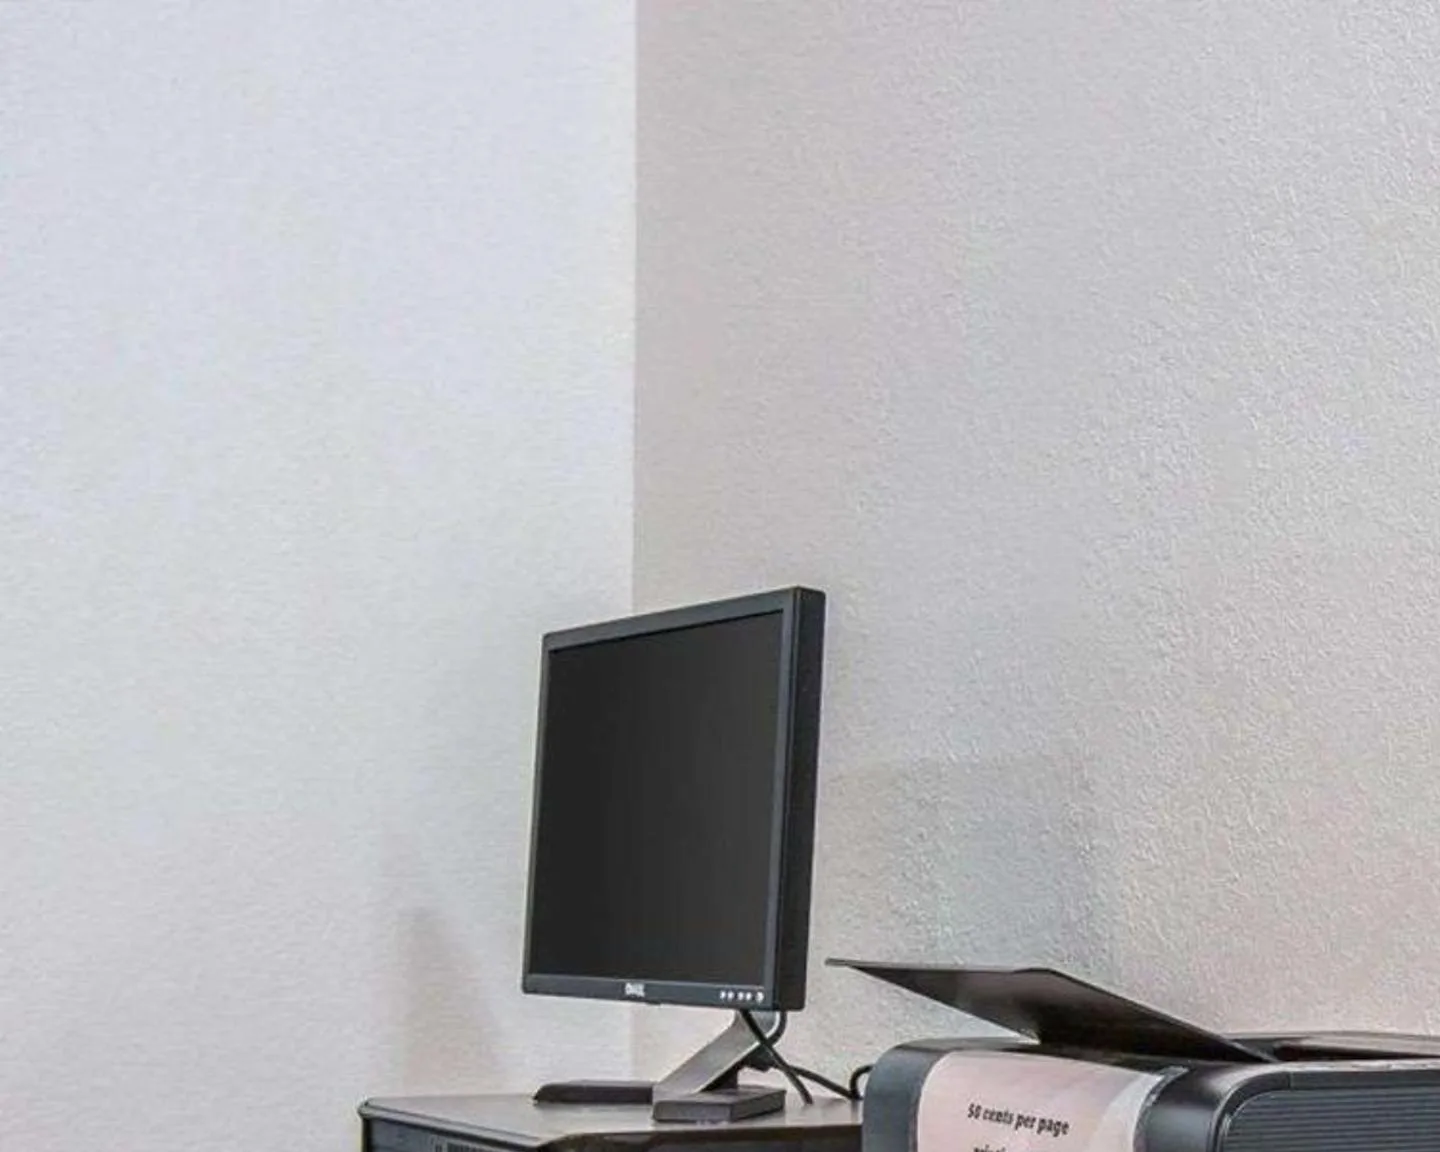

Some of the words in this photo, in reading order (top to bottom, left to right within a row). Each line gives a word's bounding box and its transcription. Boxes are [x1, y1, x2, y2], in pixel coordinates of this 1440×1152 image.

[967, 1102, 983, 1120] 50
[982, 1108, 1014, 1125] cents
[1015, 1112, 1037, 1131] per
[1037, 1118, 1071, 1138] page
